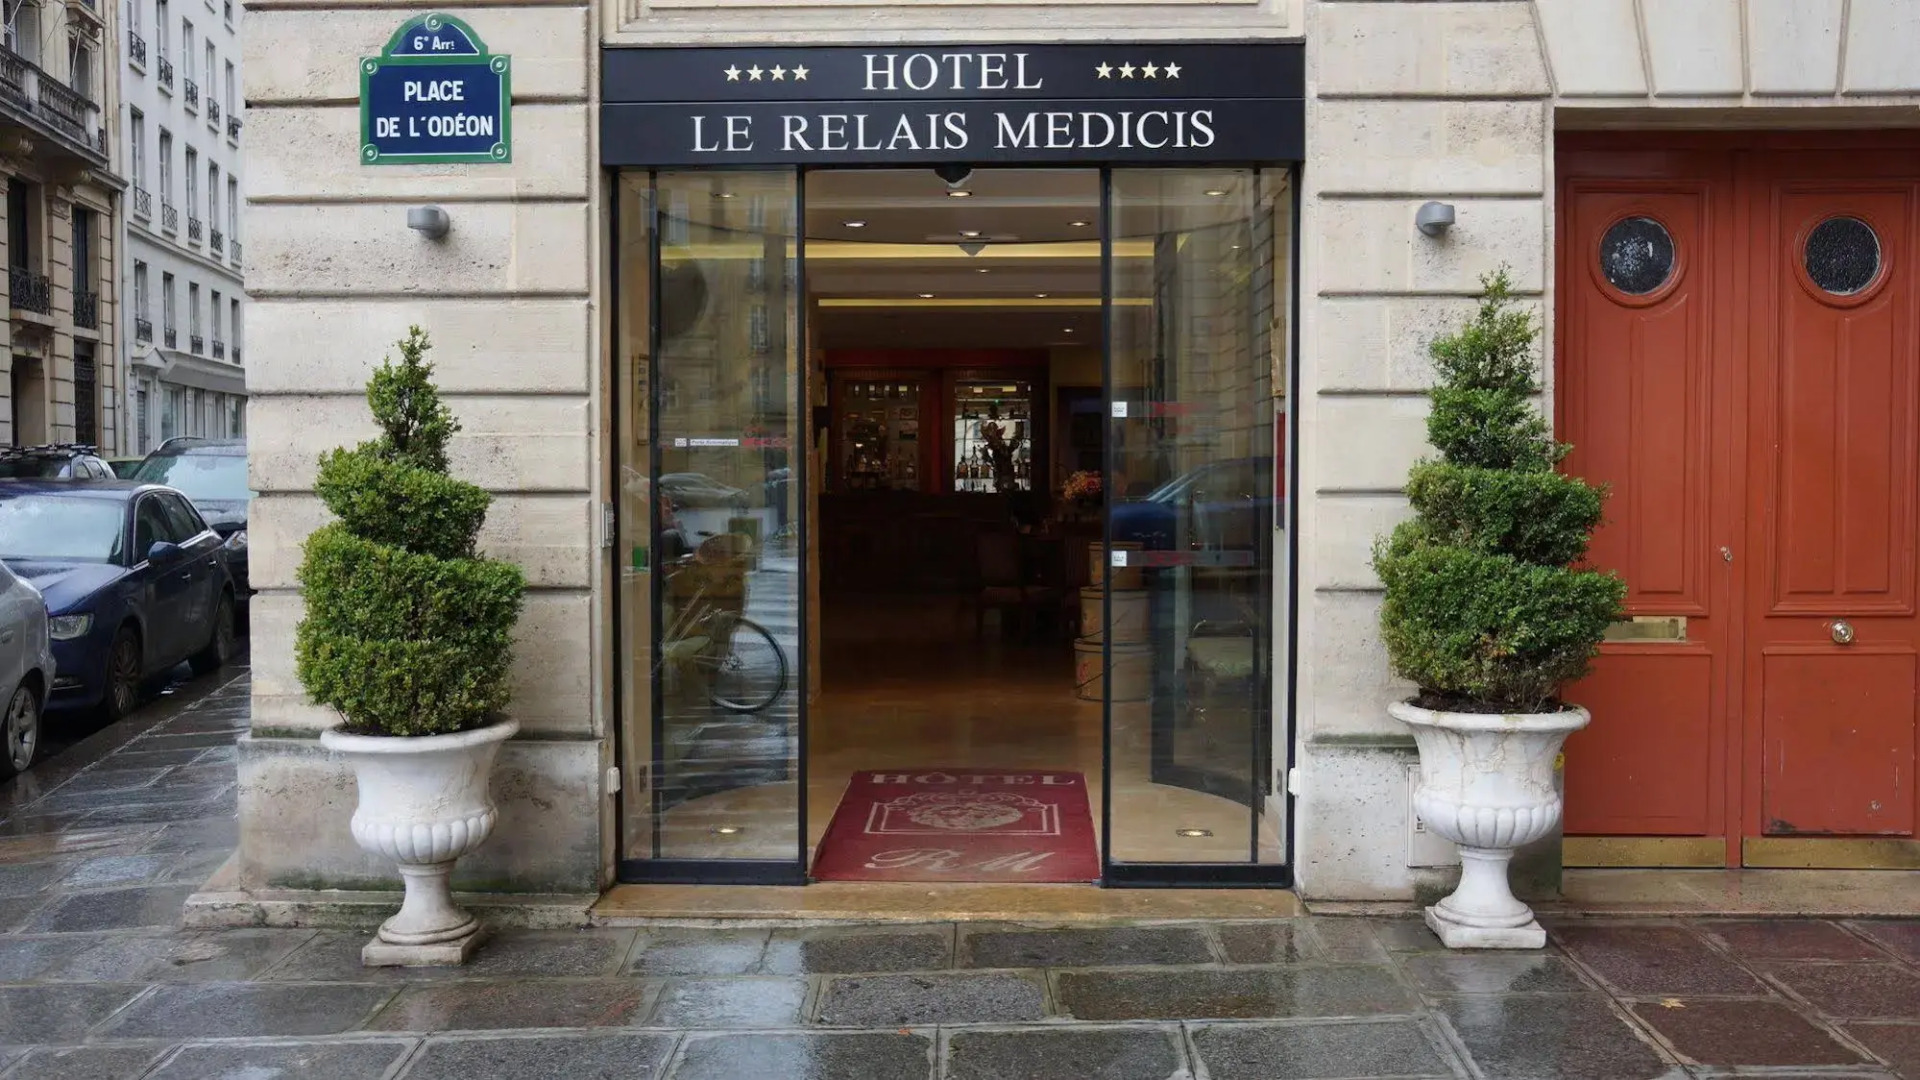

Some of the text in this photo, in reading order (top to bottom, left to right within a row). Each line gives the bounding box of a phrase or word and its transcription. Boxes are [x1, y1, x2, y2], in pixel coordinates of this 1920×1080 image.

[862, 53, 1043, 91] HOTEL
[404, 81, 464, 102] PLACE
[376, 116, 401, 138] DE
[690, 109, 1215, 152] LE RELAIS MEDICIS
